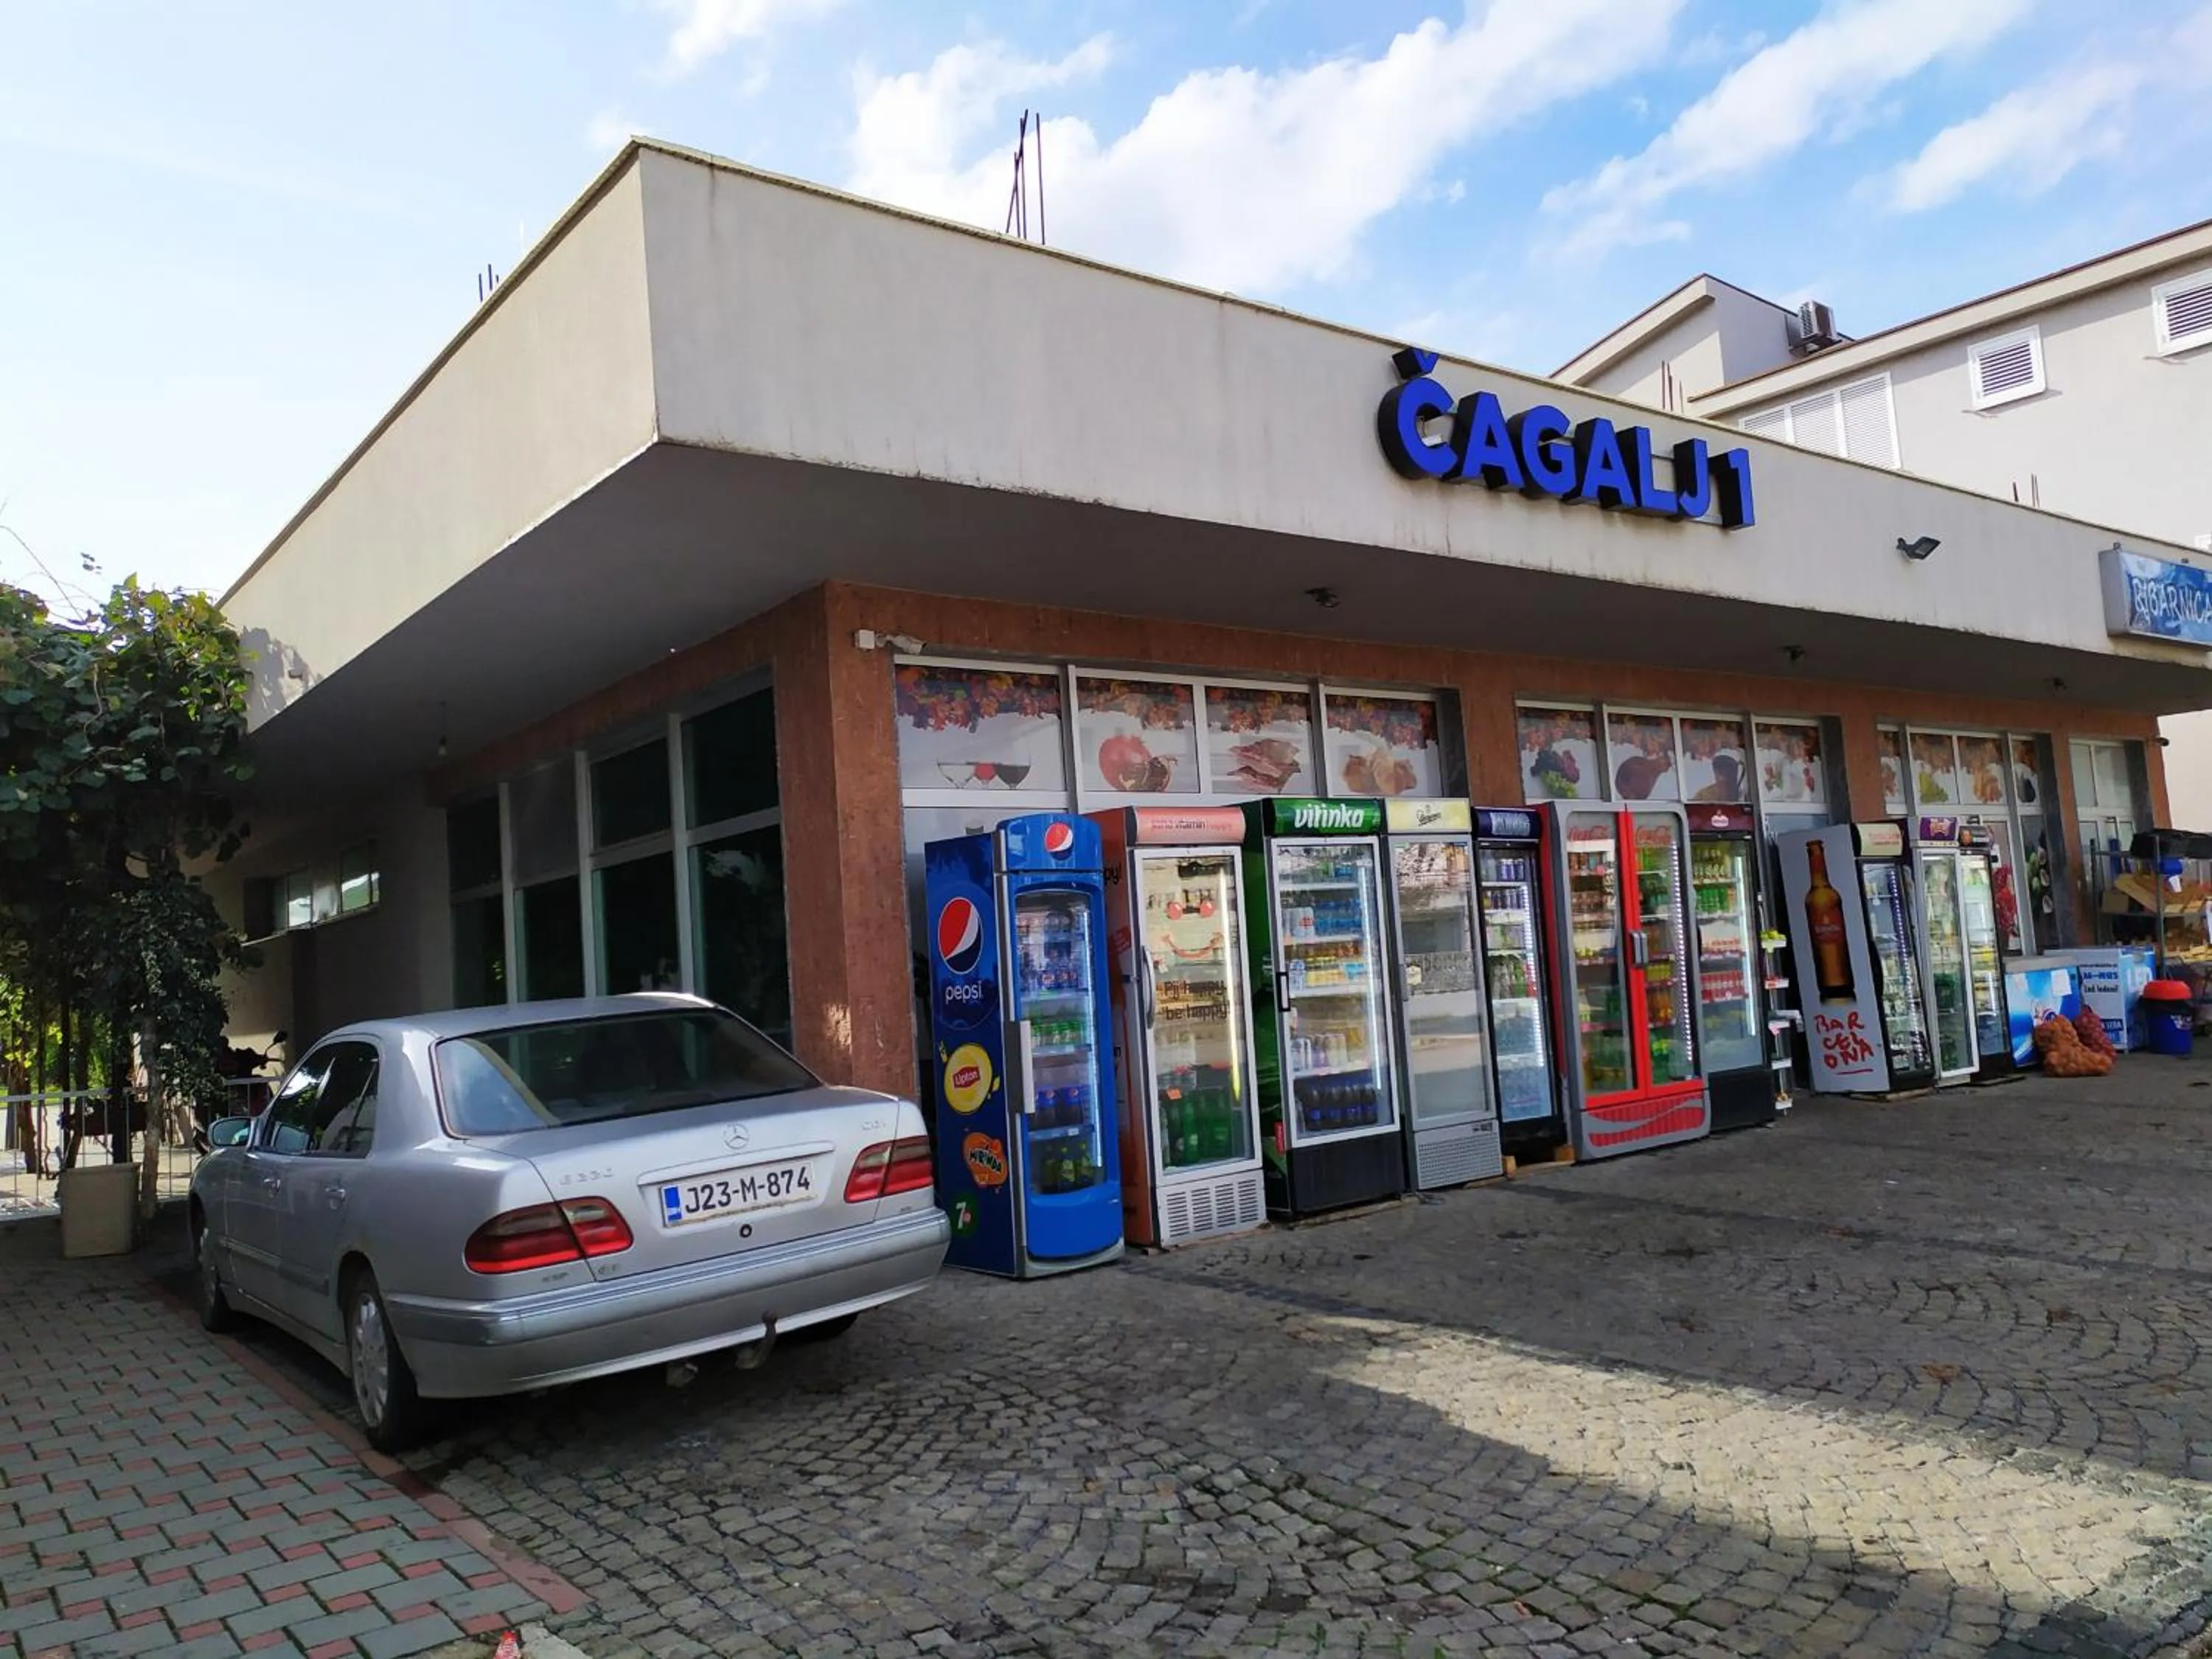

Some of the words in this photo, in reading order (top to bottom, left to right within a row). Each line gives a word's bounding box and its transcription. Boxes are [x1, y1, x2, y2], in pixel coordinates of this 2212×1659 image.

[1388, 347, 1711, 519] ČAGALJ
[1719, 447, 1756, 529] 1
[1294, 803, 1364, 829] vitinka
[945, 980, 982, 1005] pepsi
[685, 1166, 810, 1214] J23-M-874
